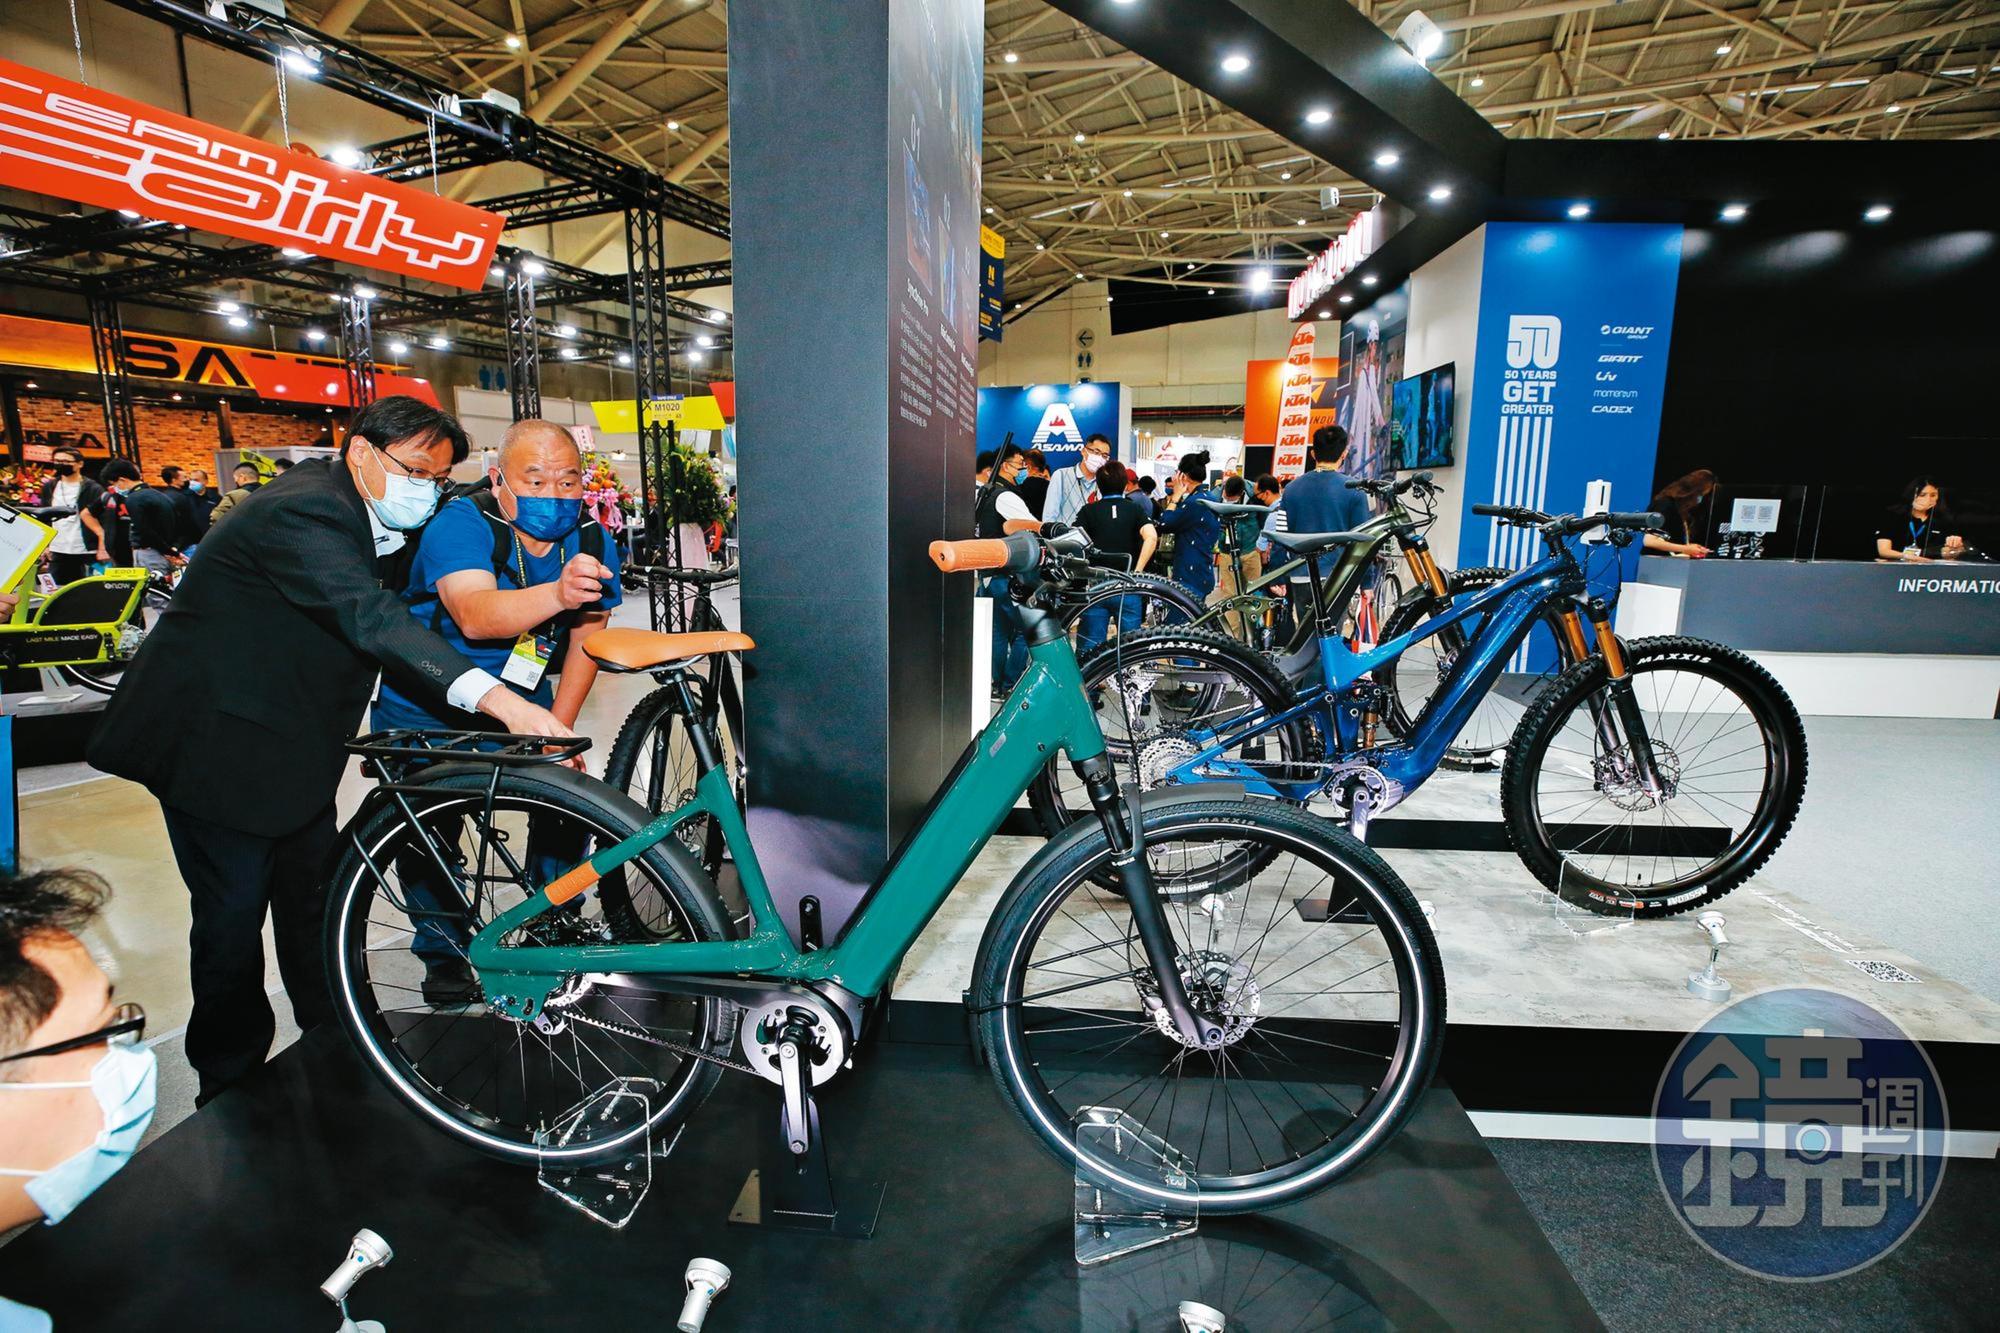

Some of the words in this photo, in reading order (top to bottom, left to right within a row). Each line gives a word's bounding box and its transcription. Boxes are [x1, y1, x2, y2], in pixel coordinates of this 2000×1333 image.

[1612, 326, 1654, 335] GIANT
[1506, 315, 1562, 369] 50
[1505, 371, 1518, 379] 50
[1521, 371, 1557, 379] YEARS
[1595, 371, 1617, 381] Liv
[1503, 381, 1556, 402] GET
[1285, 394, 1310, 407] KTM
[1501, 404, 1554, 414] GREATER
[1282, 415, 1308, 427] KTM
[1309, 415, 1335, 425] INDU
[1280, 434, 1305, 447] KTM
[1031, 443, 1085, 452] ASAMA
[1277, 454, 1302, 466] KTM
[1148, 641, 1220, 655] MAXXIS
[1636, 653, 1712, 665] MAXXIS
[1198, 817, 1256, 826] MAXXIS
